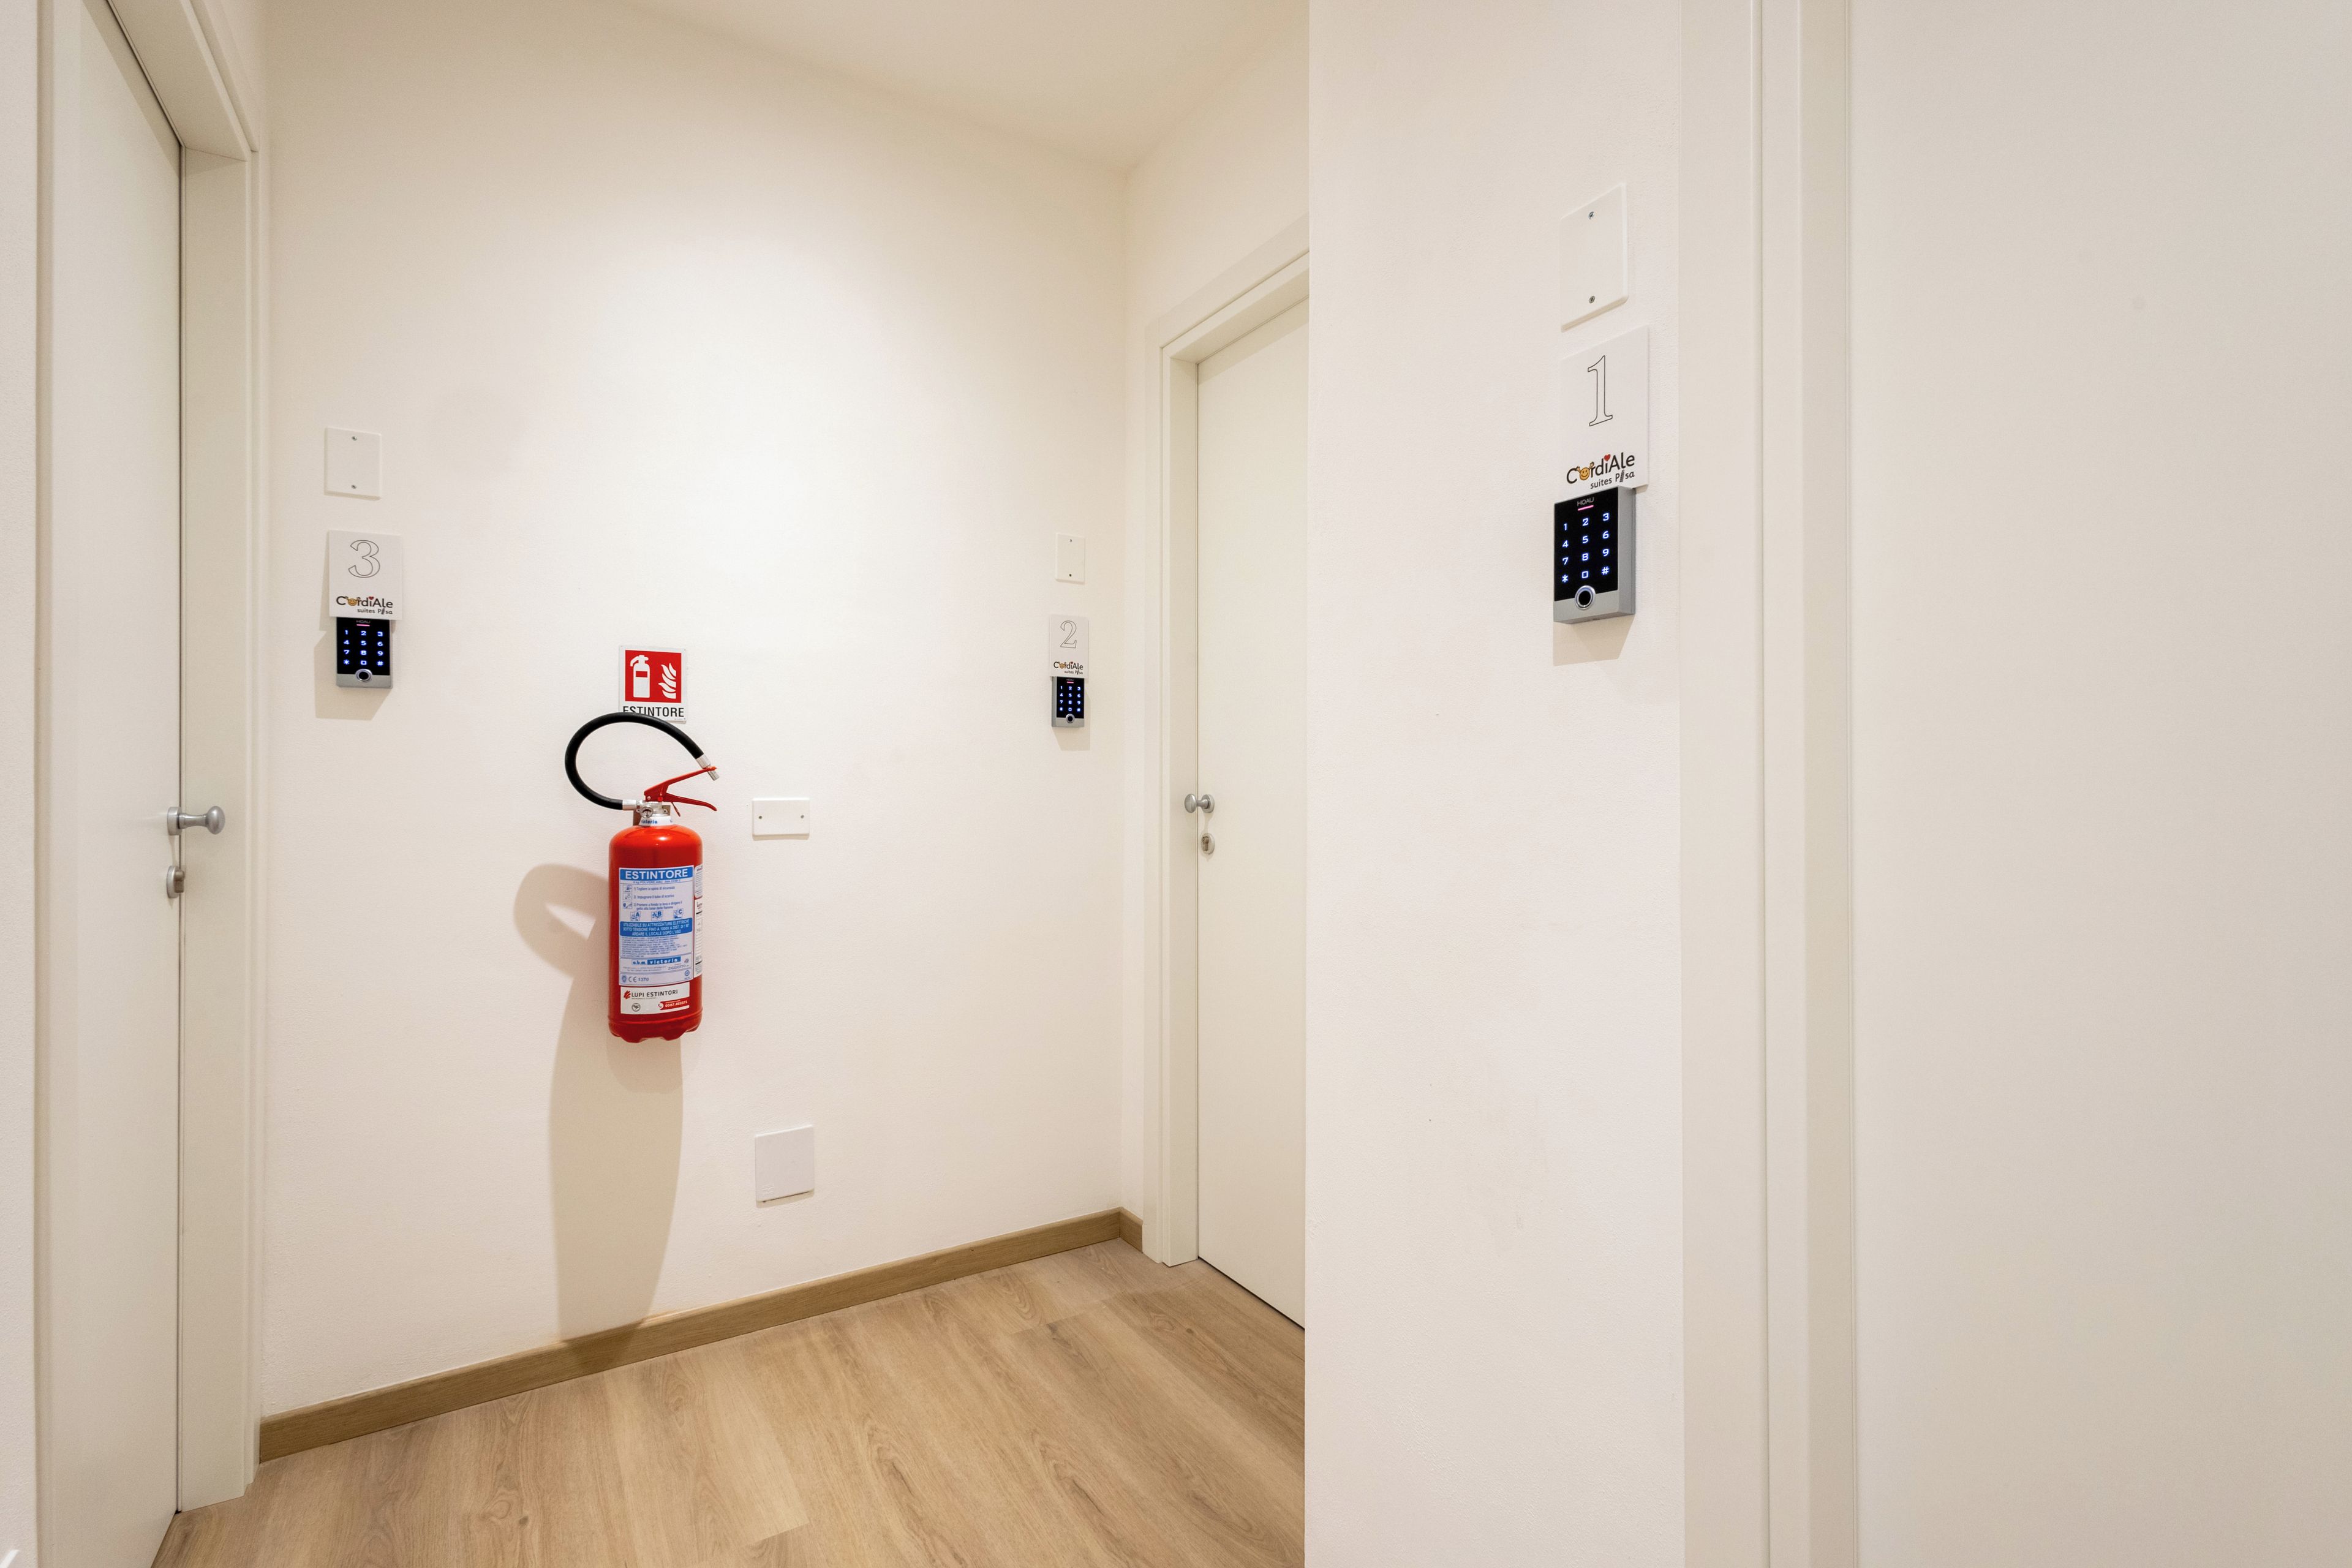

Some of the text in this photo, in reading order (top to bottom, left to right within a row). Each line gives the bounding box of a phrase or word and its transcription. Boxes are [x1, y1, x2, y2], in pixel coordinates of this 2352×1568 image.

[1588, 355, 1613, 427] 1
[1566, 452, 1635, 484] CordiAle
[1590, 478, 1612, 489] suites
[1603, 513, 1609, 521] 3
[1582, 535, 1588, 544] 5
[348, 540, 380, 578] 3
[336, 596, 393, 608] CordiAle
[1060, 620, 1077, 649] 2
[623, 706, 684, 717] ESTINTORE
[625, 869, 688, 880] ESTINTORE
